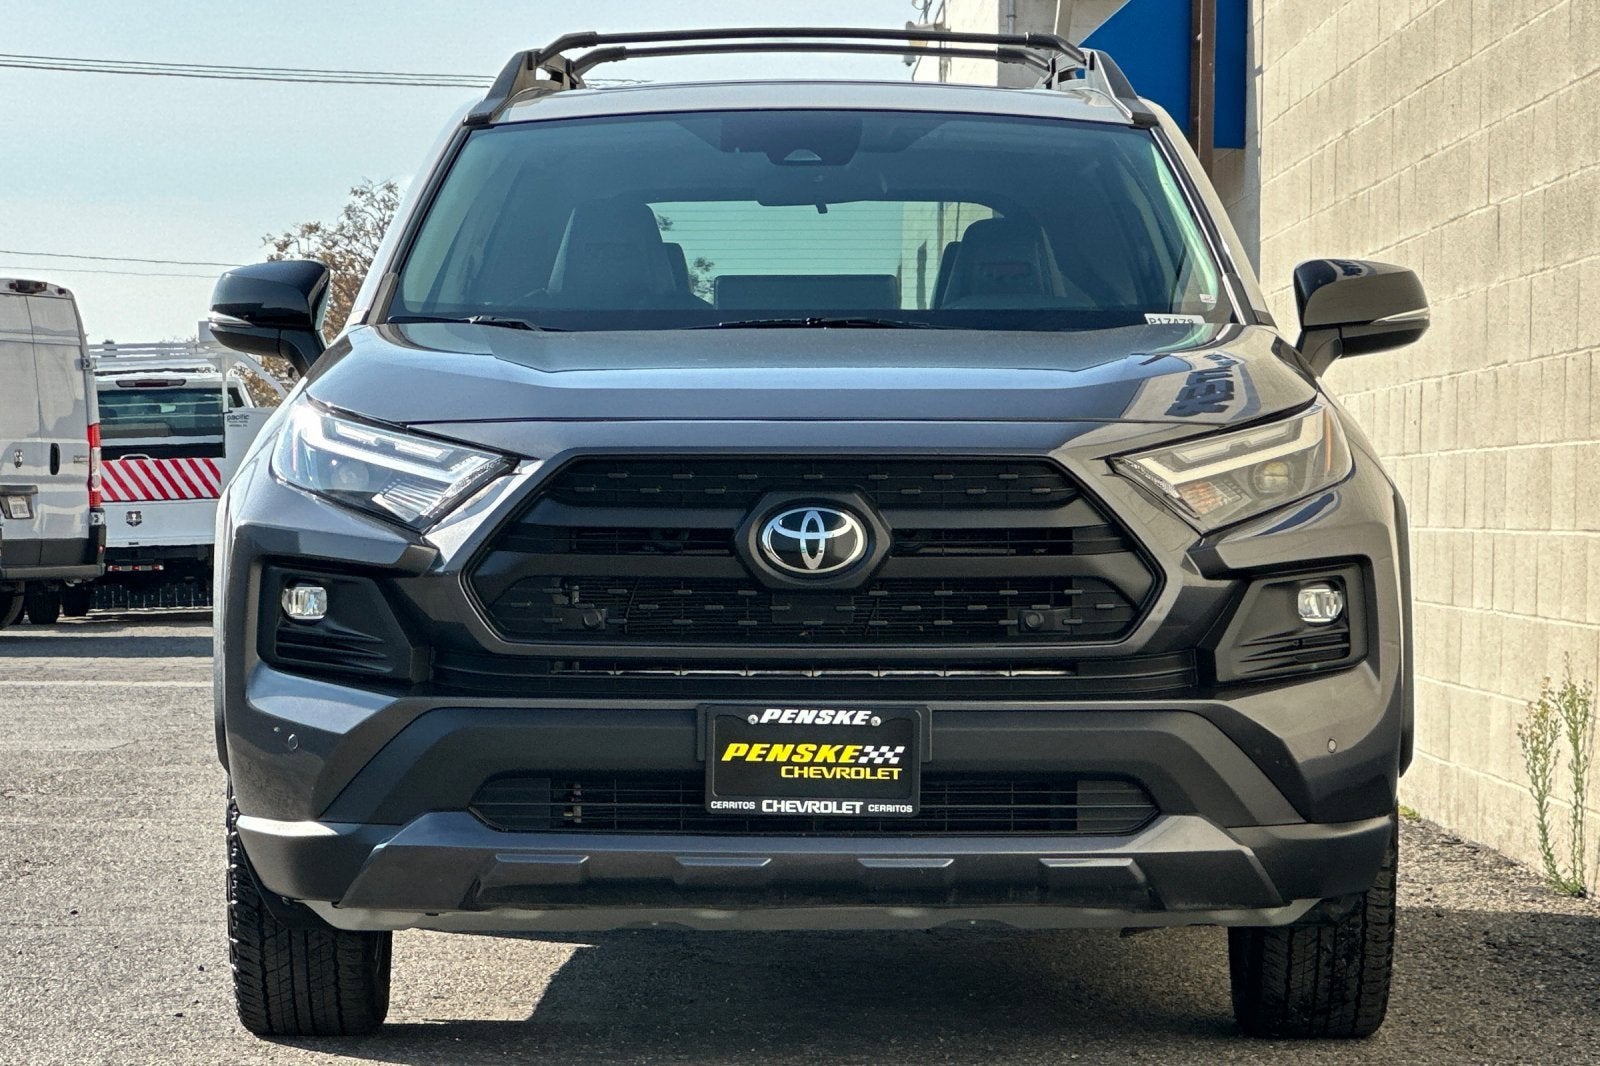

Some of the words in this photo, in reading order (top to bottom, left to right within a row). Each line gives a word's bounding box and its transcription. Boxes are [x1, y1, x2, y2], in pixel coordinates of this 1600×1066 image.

[759, 708, 871, 726] PENSKE
[722, 743, 863, 763] PENSKE
[781, 766, 902, 780] CHEVROLET
[711, 801, 755, 809] CERRITOS
[762, 800, 864, 814] CHEVROLET
[868, 804, 912, 812] CERRITOS
